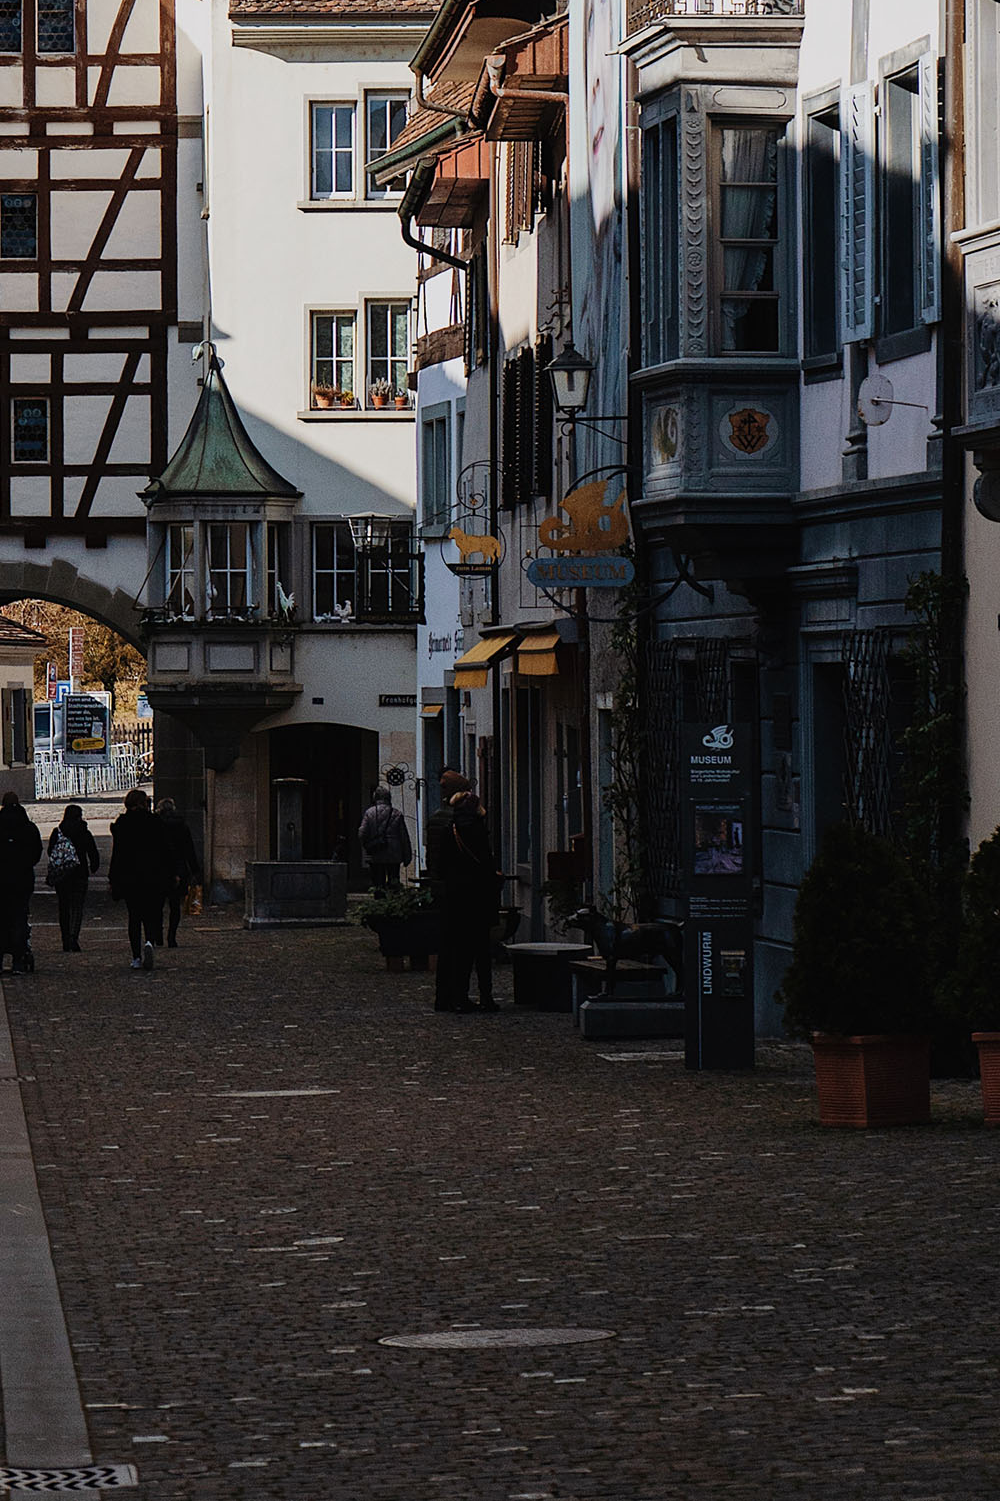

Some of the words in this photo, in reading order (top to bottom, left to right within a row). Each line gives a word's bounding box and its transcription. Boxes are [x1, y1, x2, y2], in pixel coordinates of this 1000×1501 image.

[536, 565, 626, 579] MUSEUM
[690, 755, 732, 765] MUSEUM
[702, 931, 713, 995] LINDWURM
